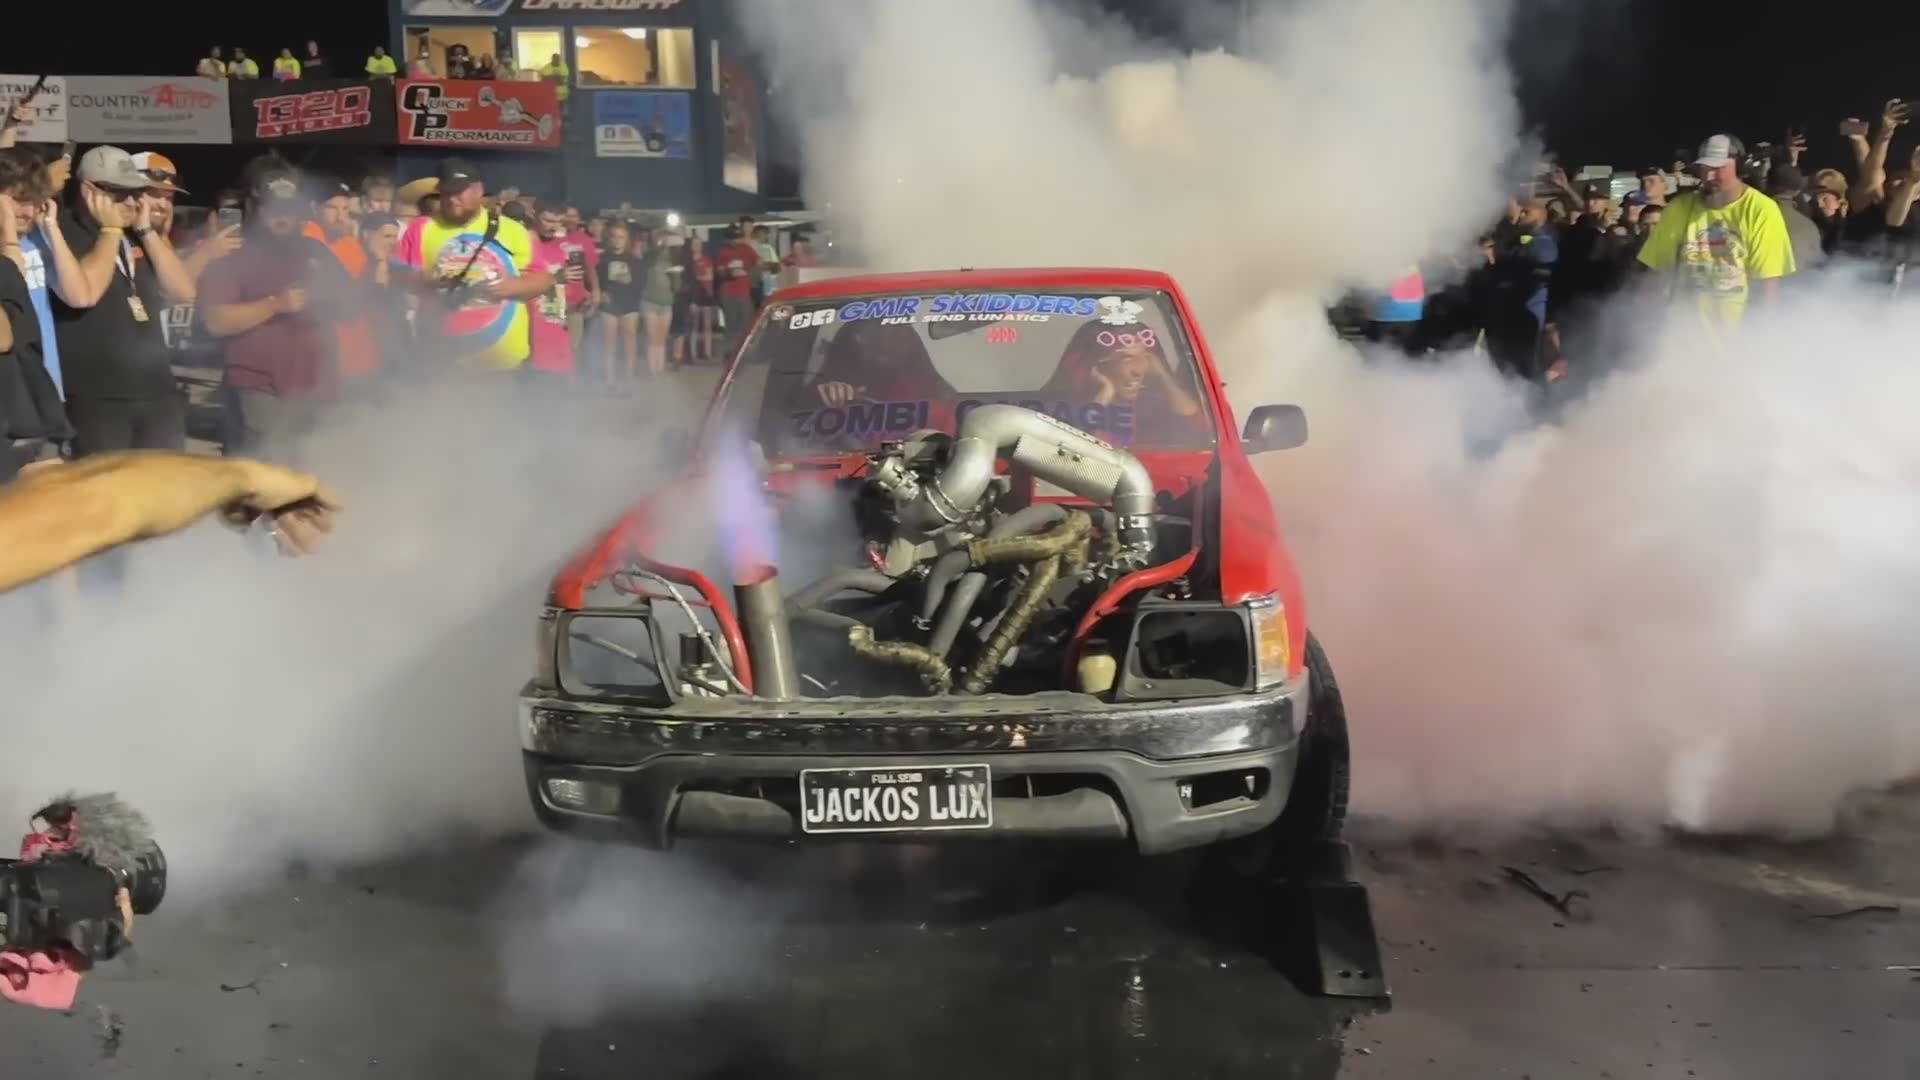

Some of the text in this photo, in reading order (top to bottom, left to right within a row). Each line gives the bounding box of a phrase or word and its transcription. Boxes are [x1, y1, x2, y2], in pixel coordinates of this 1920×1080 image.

[70, 84, 211, 108] COUNTRY AUTO
[253, 86, 371, 120] 1320
[402, 83, 471, 113] QUICK
[411, 112, 534, 142] PERFORMANCE
[839, 294, 1096, 321] GMR SKIDDERS
[881, 312, 1050, 325] FULL SEND LUNATICS
[871, 773, 897, 784] FULL
[806, 783, 987, 823] JACKOS LUX
